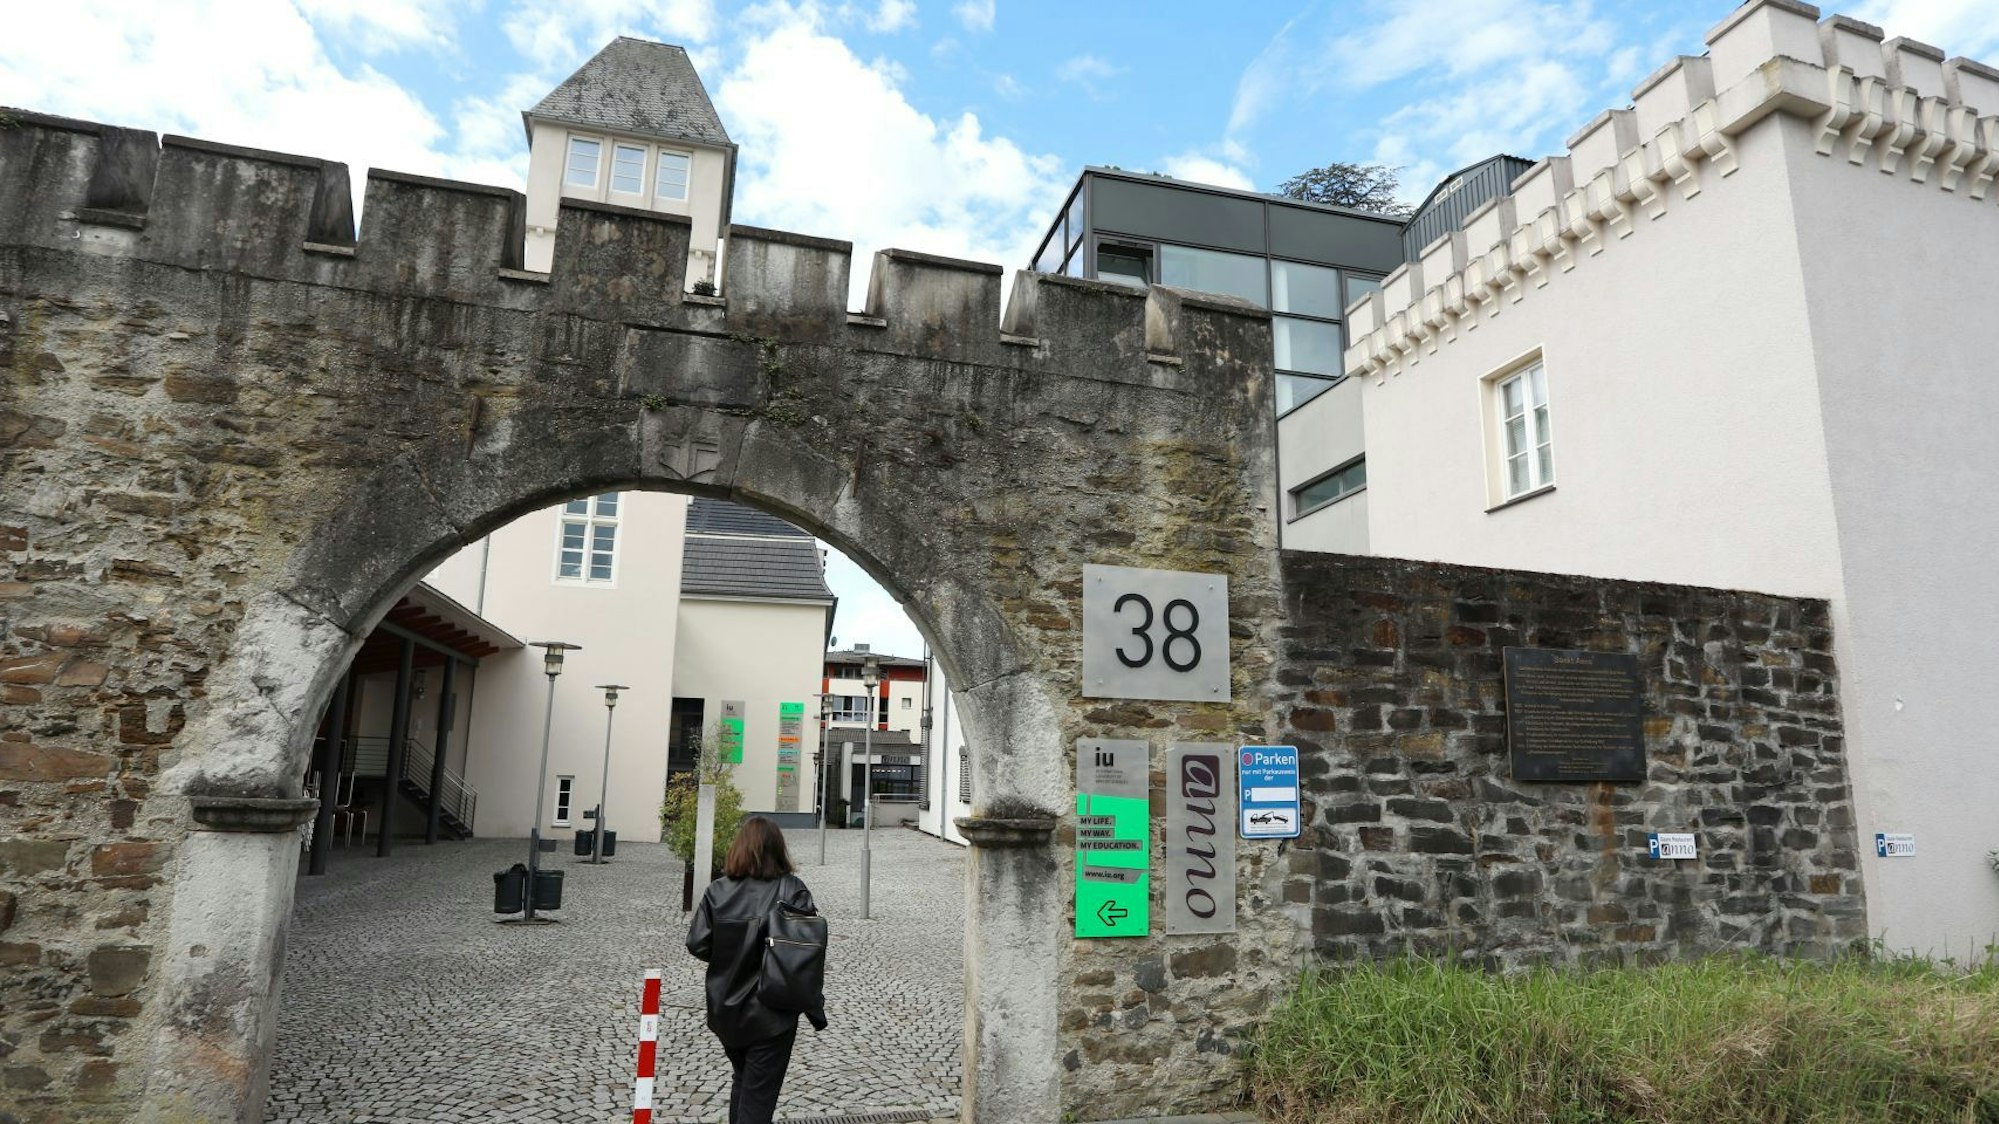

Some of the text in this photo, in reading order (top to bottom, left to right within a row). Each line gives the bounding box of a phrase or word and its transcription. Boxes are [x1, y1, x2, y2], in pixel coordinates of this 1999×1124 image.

[1114, 593, 1202, 673] 38
[1095, 746, 1114, 767] iu
[1255, 752, 1296, 765] Parken
[1244, 789, 1251, 800] P
[1080, 817, 1112, 825] MY LIFE.
[1080, 829, 1111, 837] MY WAY.
[1185, 758, 1217, 919] anno
[1080, 841, 1140, 850] MY EDUCATION.
[1649, 838, 1659, 854] P
[1661, 844, 1694, 855] anno
[1877, 838, 1885, 852] P
[1887, 842, 1914, 854] anno
[1085, 870, 1125, 881] www.iu.org
